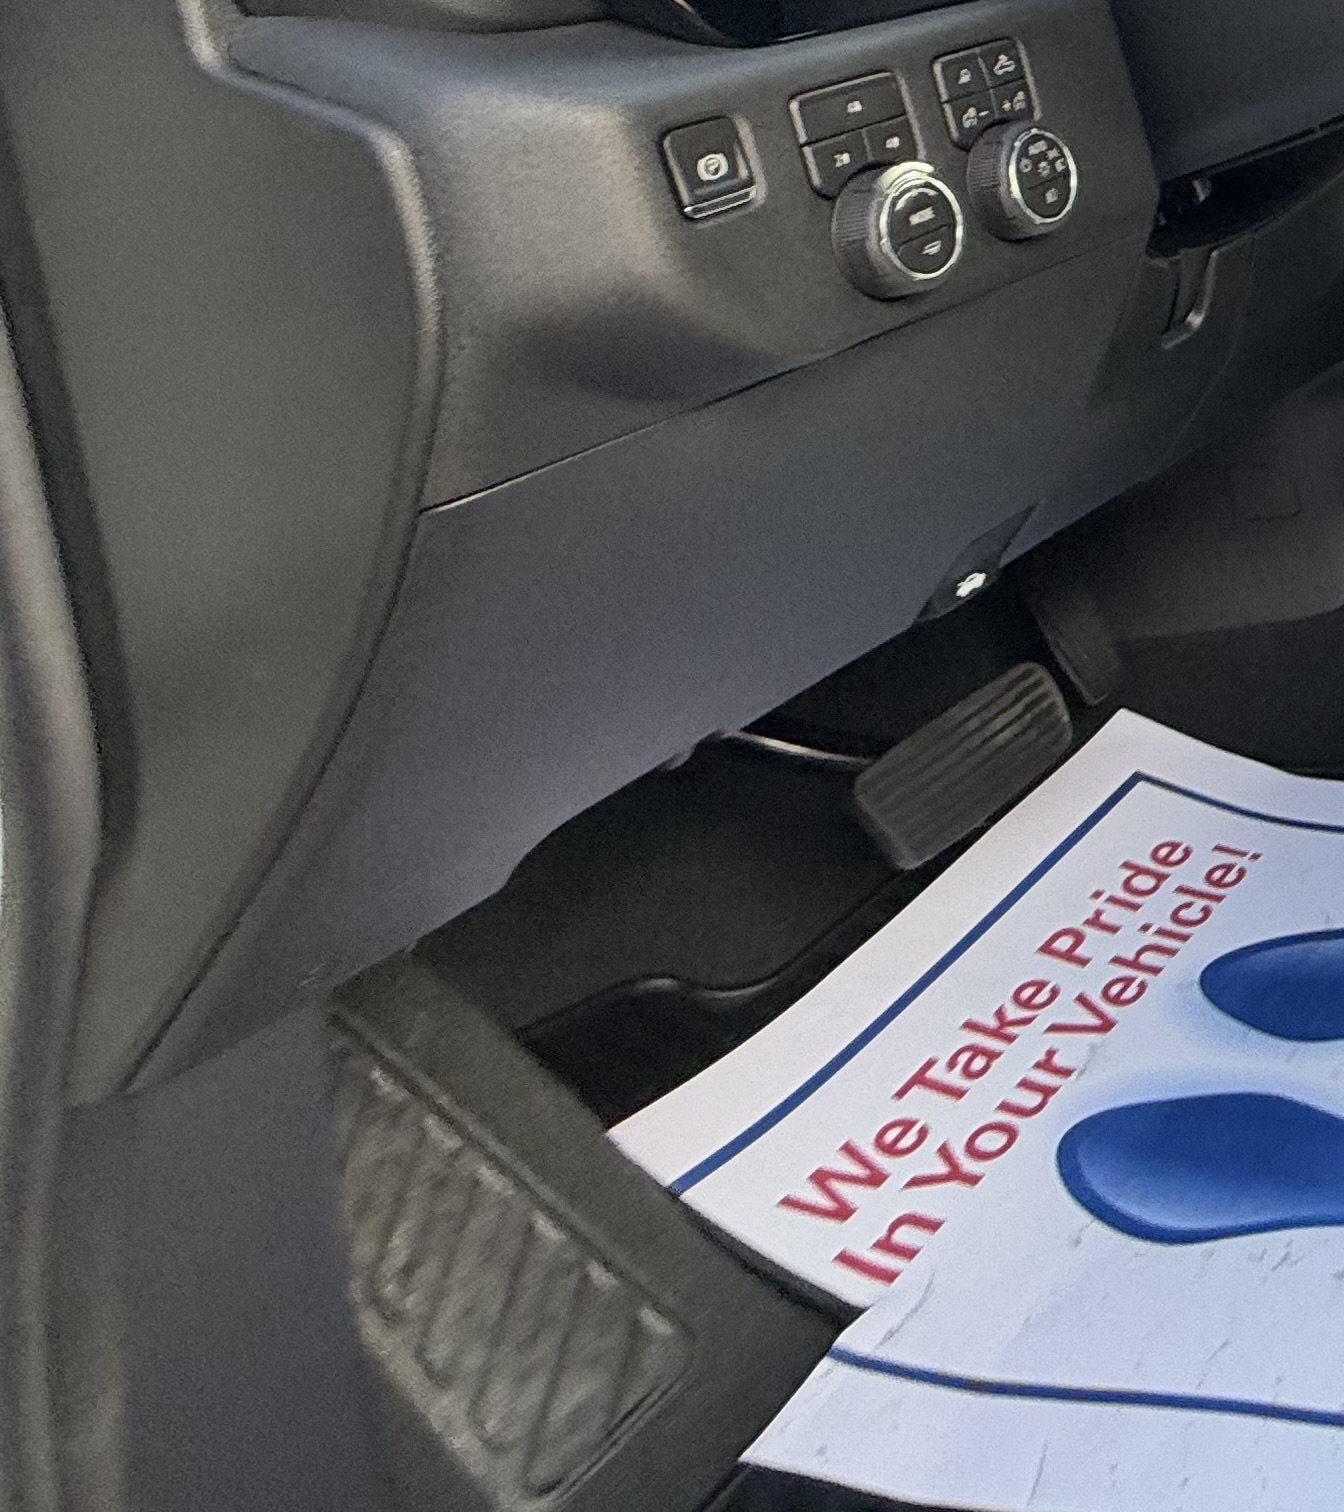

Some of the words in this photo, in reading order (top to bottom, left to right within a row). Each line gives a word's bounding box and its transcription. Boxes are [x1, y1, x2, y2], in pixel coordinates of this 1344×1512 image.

[777, 1116, 930, 1224] We
[891, 978, 1061, 1101] Take
[1035, 839, 1193, 968] Pride
[832, 1209, 946, 1285] In
[900, 1047, 1076, 1190] Your
[1043, 844, 1264, 1035] Vehicle!
